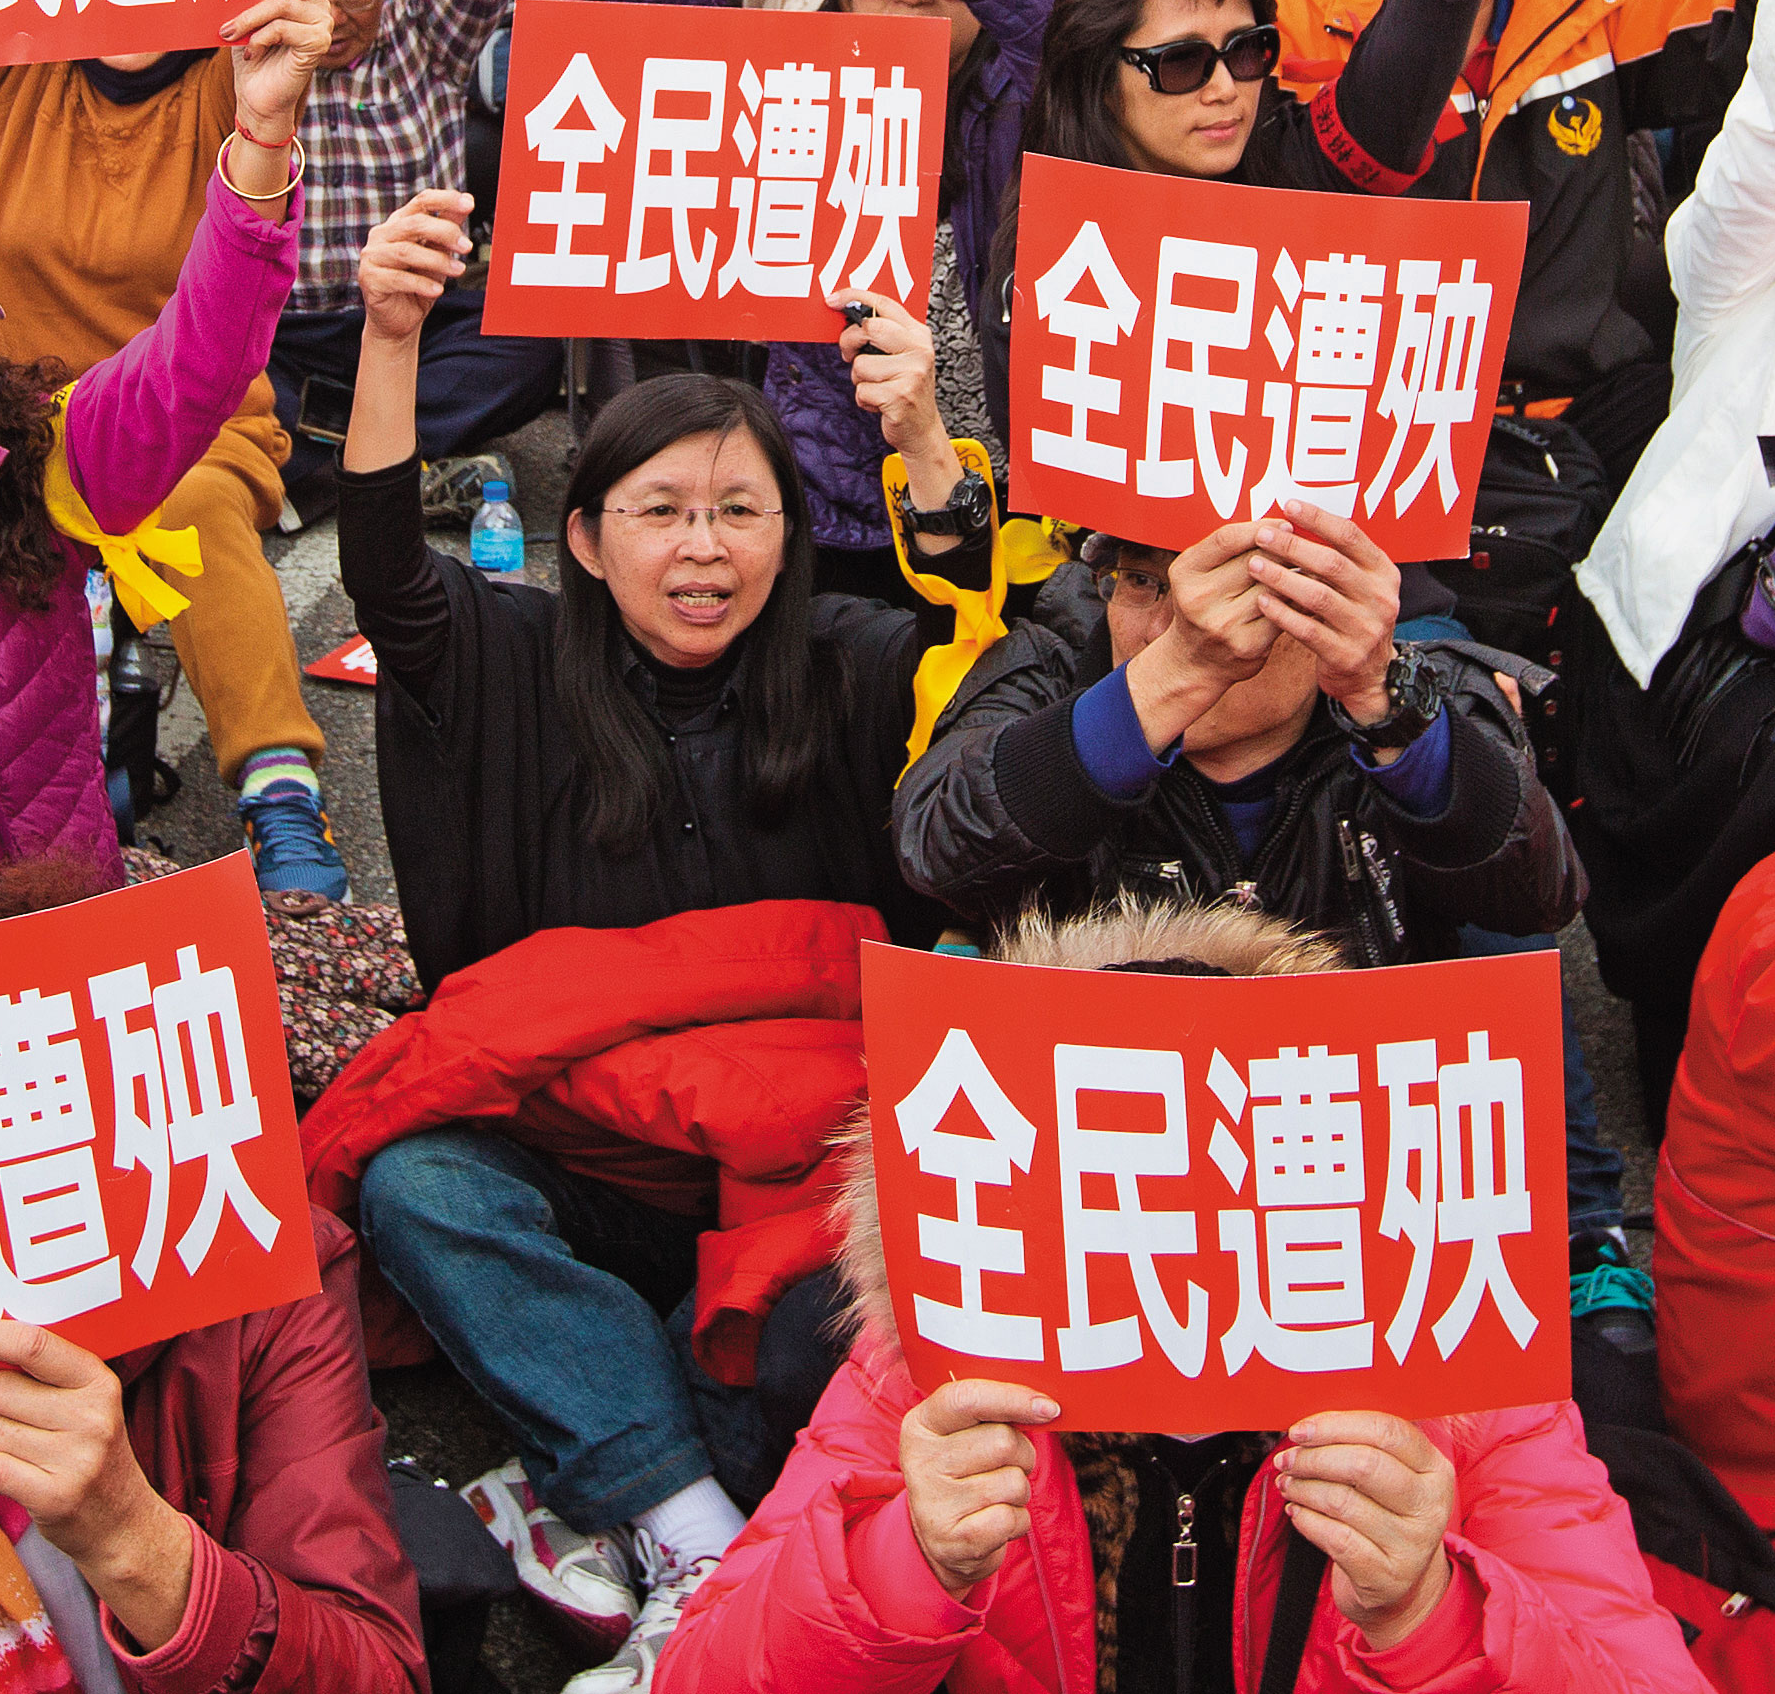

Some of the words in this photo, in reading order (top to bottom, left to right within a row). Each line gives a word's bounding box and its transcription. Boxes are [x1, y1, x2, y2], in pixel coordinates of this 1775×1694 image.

[512, 51, 924, 304] 全民遭殃
[1034, 219, 1492, 522] 全民遭殃
[893, 1028, 1540, 1379] 全民遭殃
